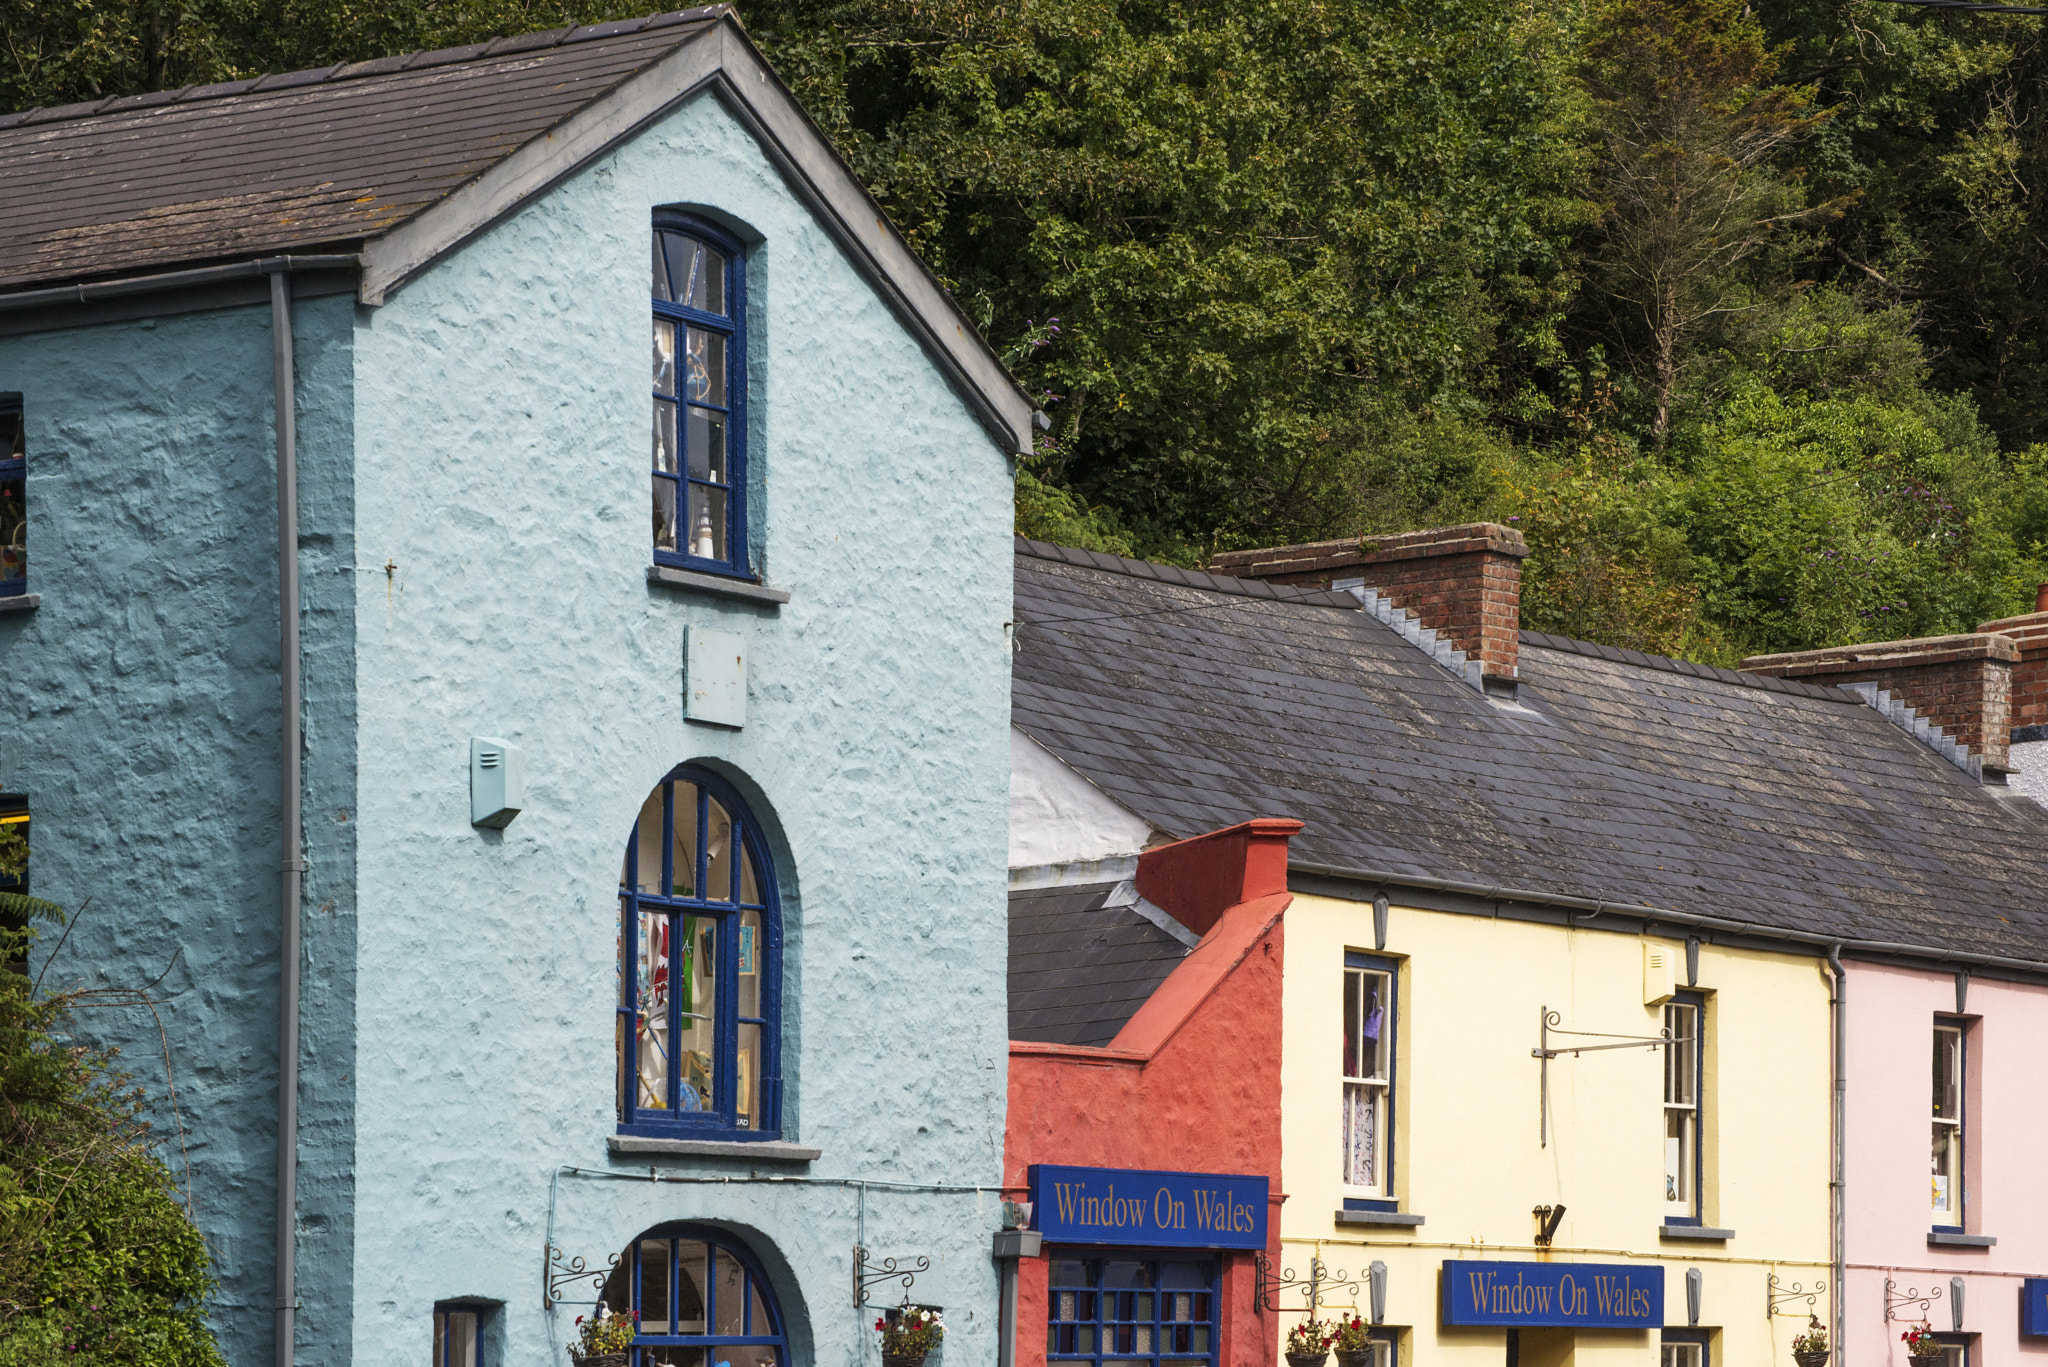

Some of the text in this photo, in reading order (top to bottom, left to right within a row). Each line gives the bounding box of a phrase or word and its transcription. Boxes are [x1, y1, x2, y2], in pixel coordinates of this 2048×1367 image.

[1055, 1182, 1254, 1233] Window On Wales
[1469, 1271, 1650, 1318] Window On Wales
